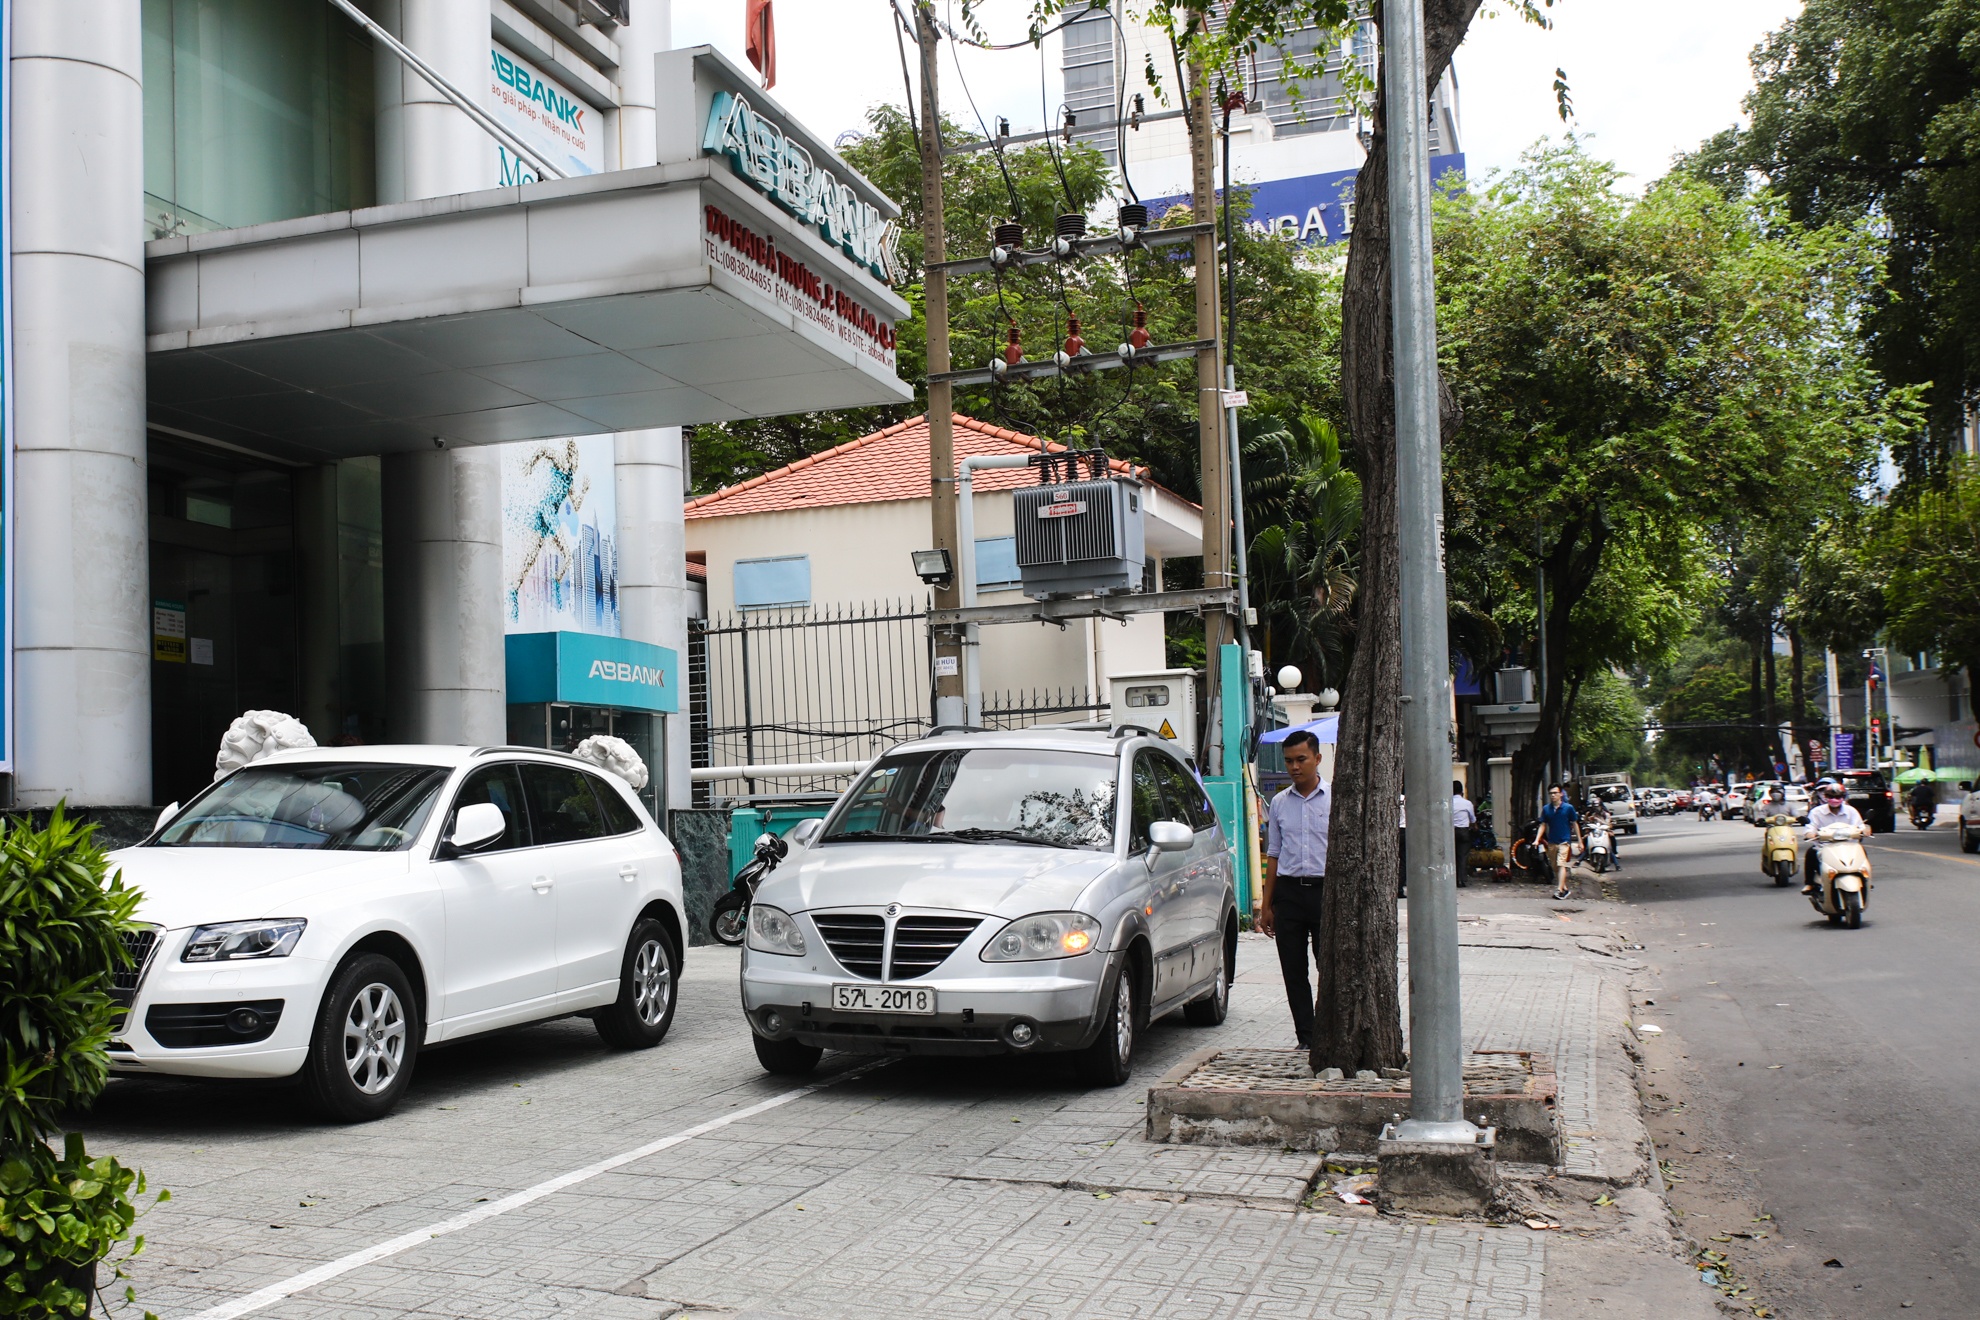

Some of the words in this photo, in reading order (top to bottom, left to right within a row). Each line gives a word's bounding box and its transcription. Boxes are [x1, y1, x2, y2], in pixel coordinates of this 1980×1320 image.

[518, 100, 536, 121] pháp
[703, 91, 896, 284] ABBANK
[705, 204, 730, 242] 170
[730, 220, 757, 260] HAI
[588, 660, 663, 688] ABBANK
